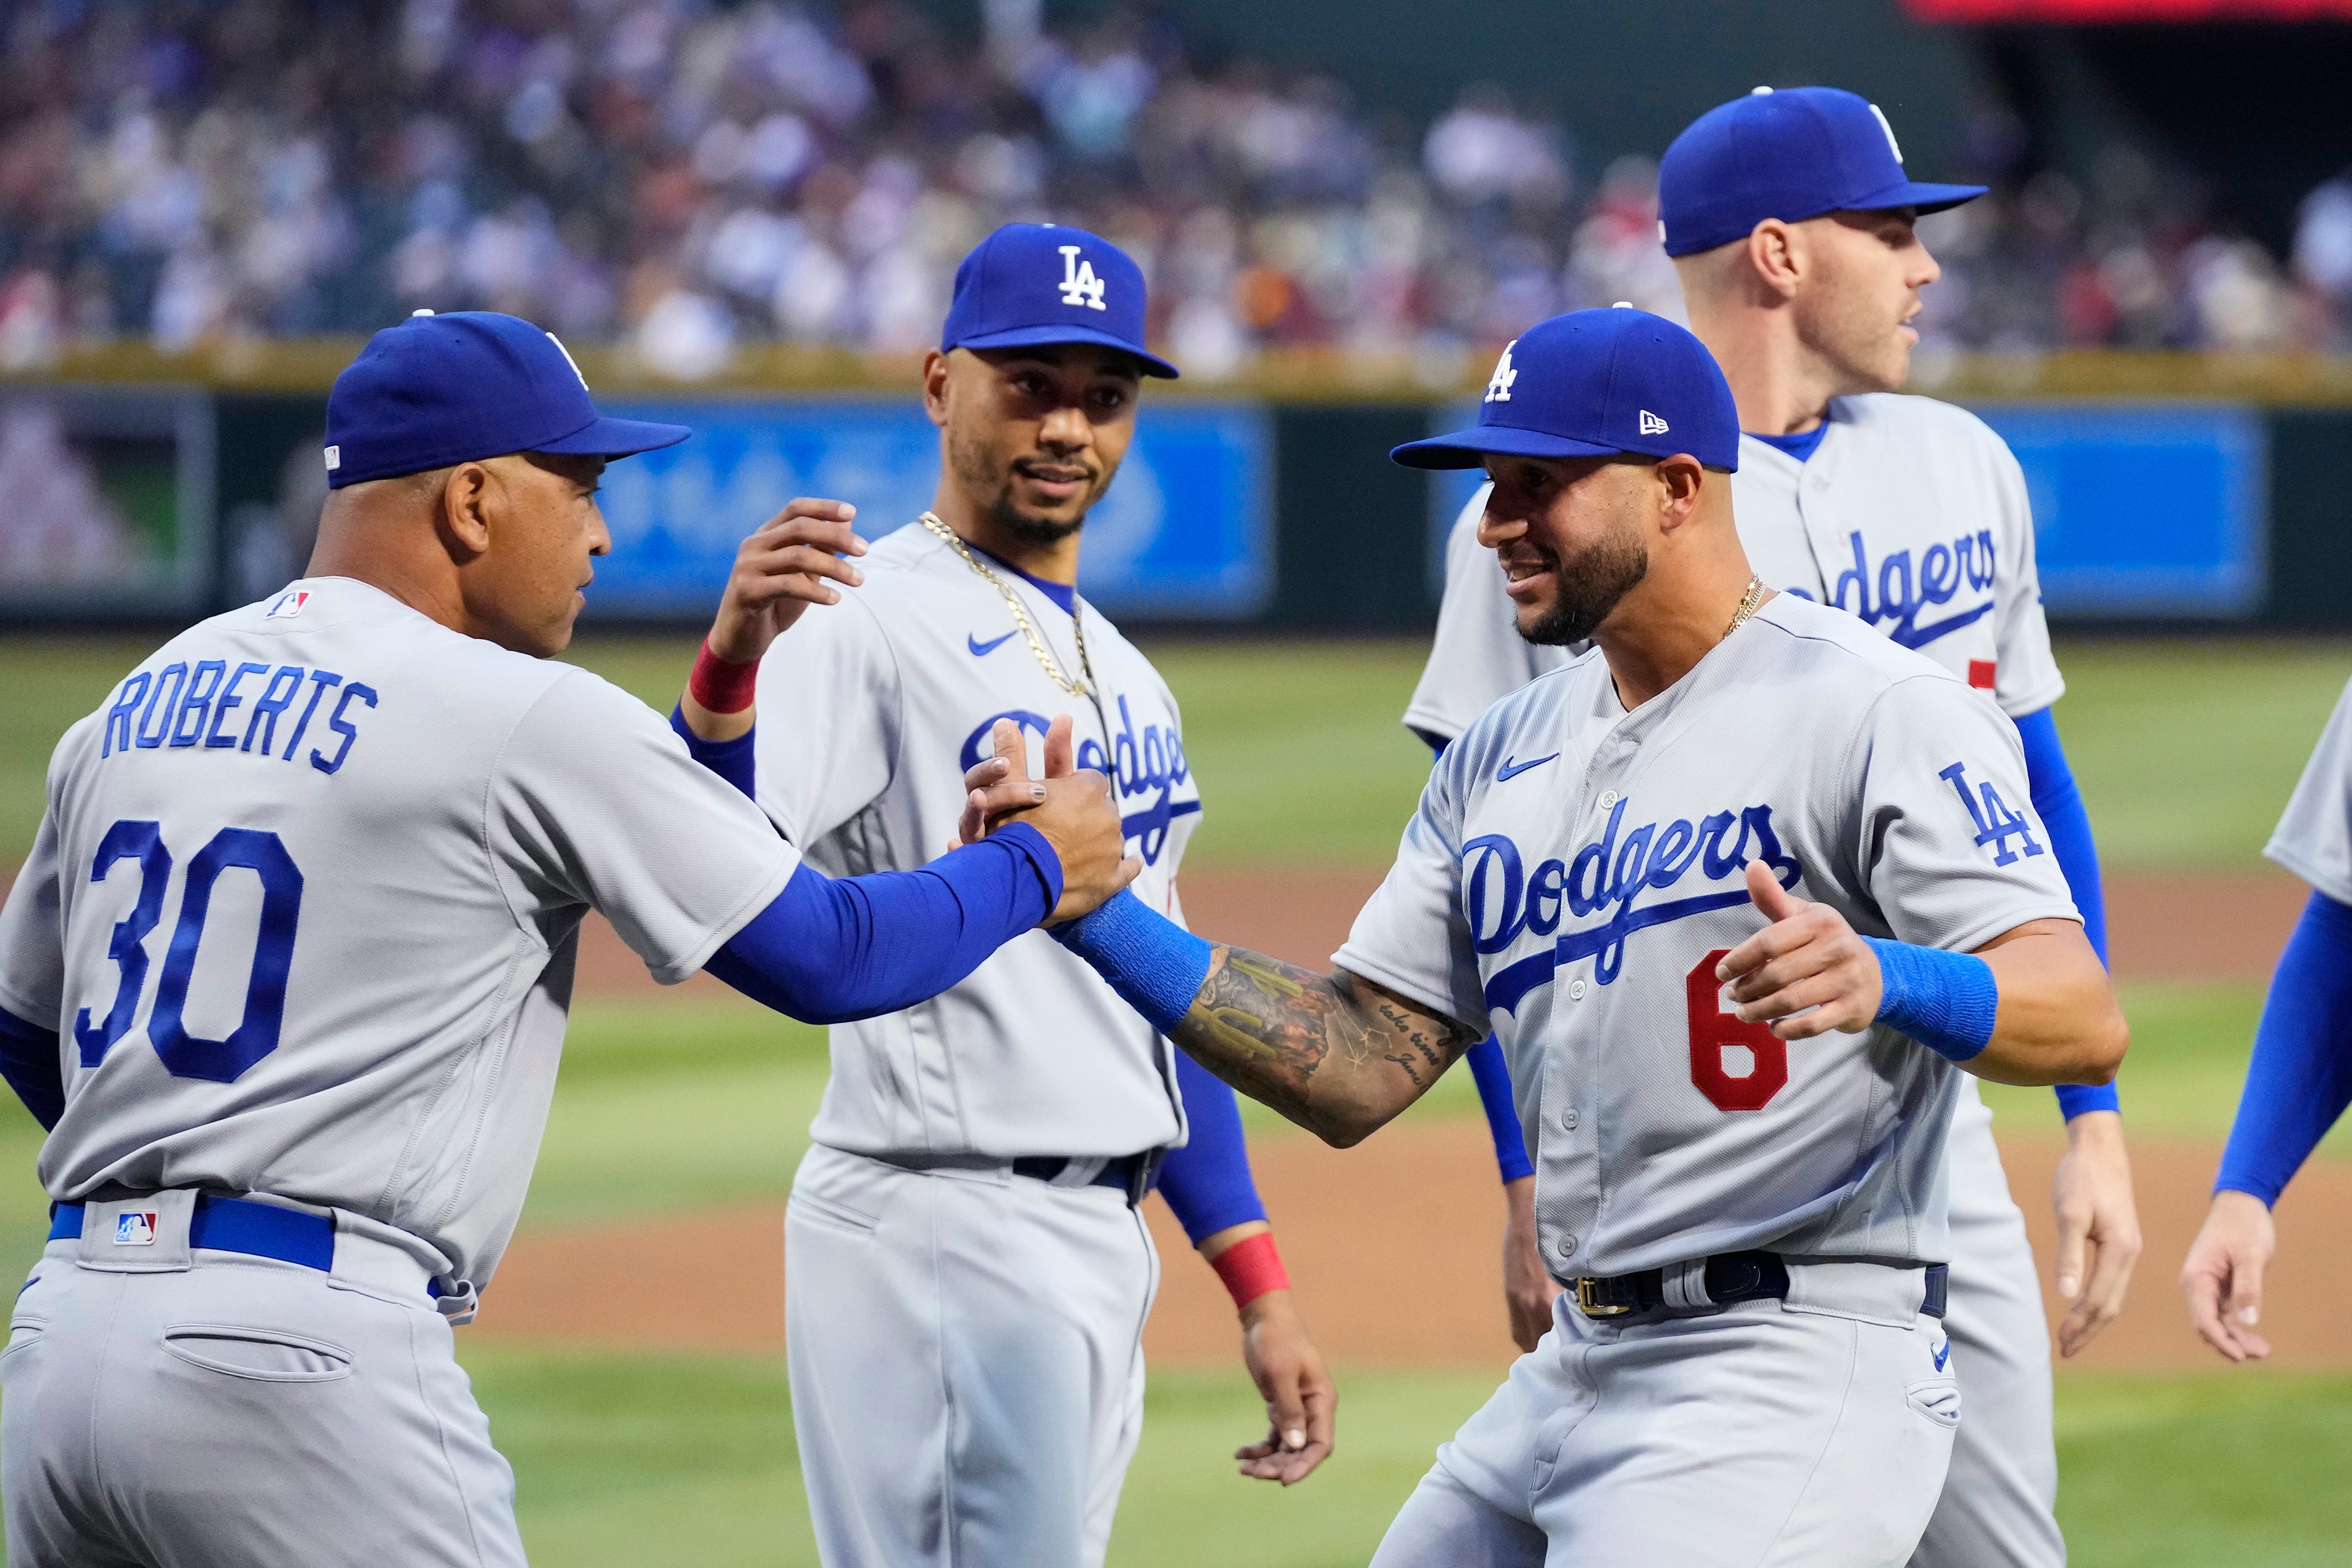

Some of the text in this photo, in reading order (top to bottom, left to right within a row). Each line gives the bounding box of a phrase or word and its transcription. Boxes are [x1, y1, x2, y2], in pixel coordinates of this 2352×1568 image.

[1058, 246, 1106, 310] LA
[101, 659, 378, 775] ROBERTS
[1938, 761, 2044, 867] LA
[74, 819, 304, 1083] 30
[1462, 796, 1802, 990] Dodgers
[1686, 949, 1788, 1111] 6
